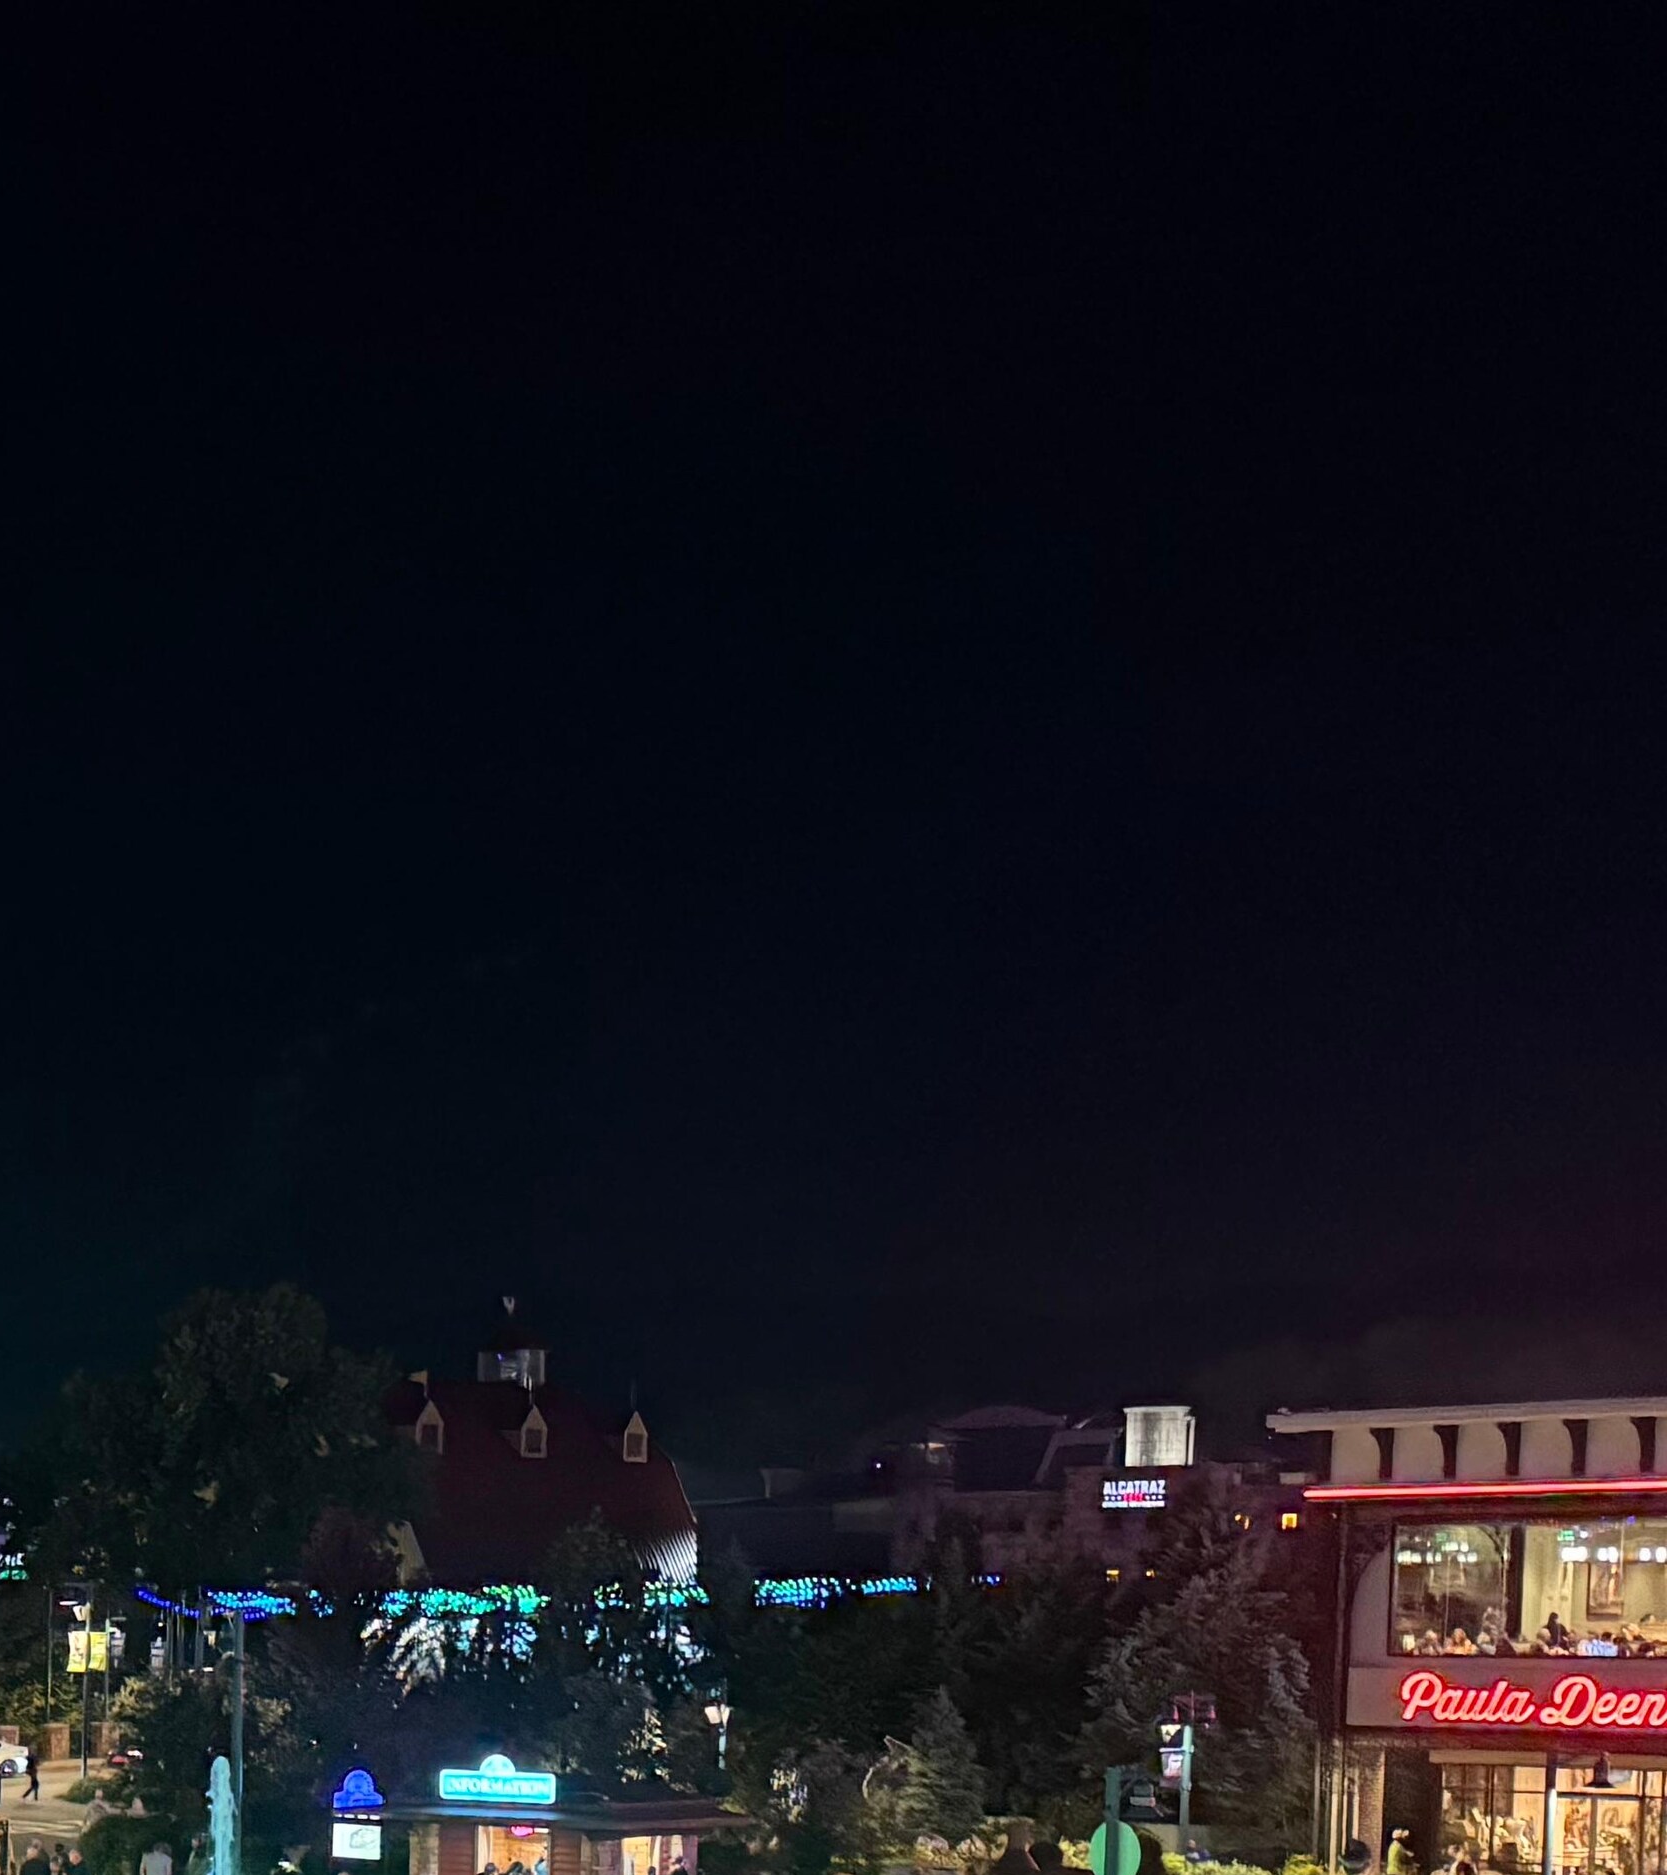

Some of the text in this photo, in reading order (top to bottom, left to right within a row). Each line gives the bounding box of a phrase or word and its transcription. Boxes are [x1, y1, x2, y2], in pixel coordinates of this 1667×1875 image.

[1103, 1479, 1166, 1495] ALCATRAZ
[1401, 1671, 1667, 1727] Paula Deen
[448, 1776, 550, 1797] INFORMATION
